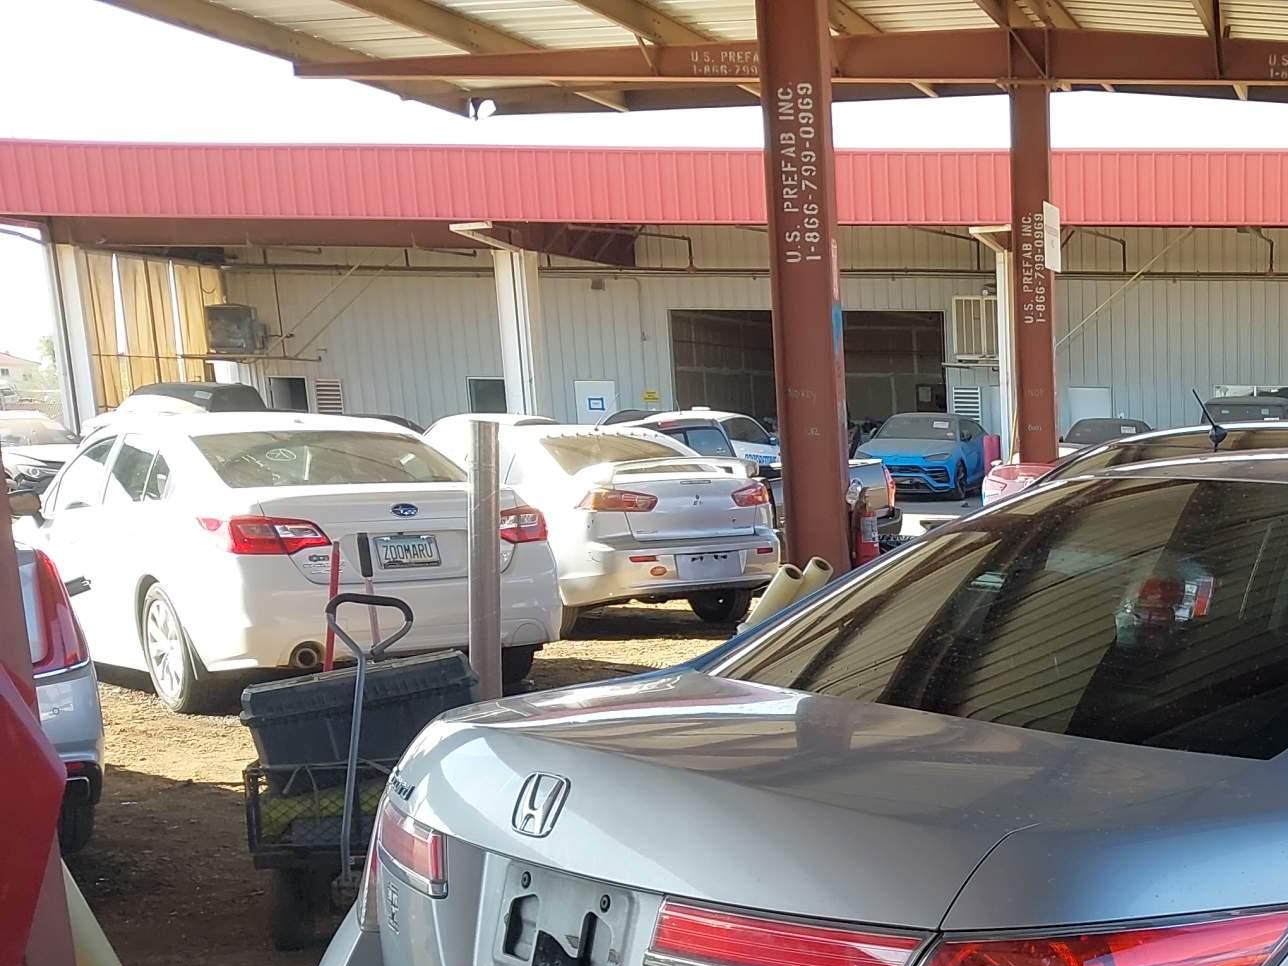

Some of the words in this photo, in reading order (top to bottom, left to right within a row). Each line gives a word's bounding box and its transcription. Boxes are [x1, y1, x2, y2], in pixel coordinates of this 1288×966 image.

[777, 82, 795, 121] INC.
[780, 132, 800, 212] PREFAB
[796, 82, 822, 261] 1-866-799-0969
[785, 225, 802, 263] U.S.
[1021, 212, 1033, 237] INC.
[1022, 243, 1034, 293] PREFAB
[1033, 213, 1047, 324] 1-866-799-0969
[1023, 300, 1035, 324] U.S.
